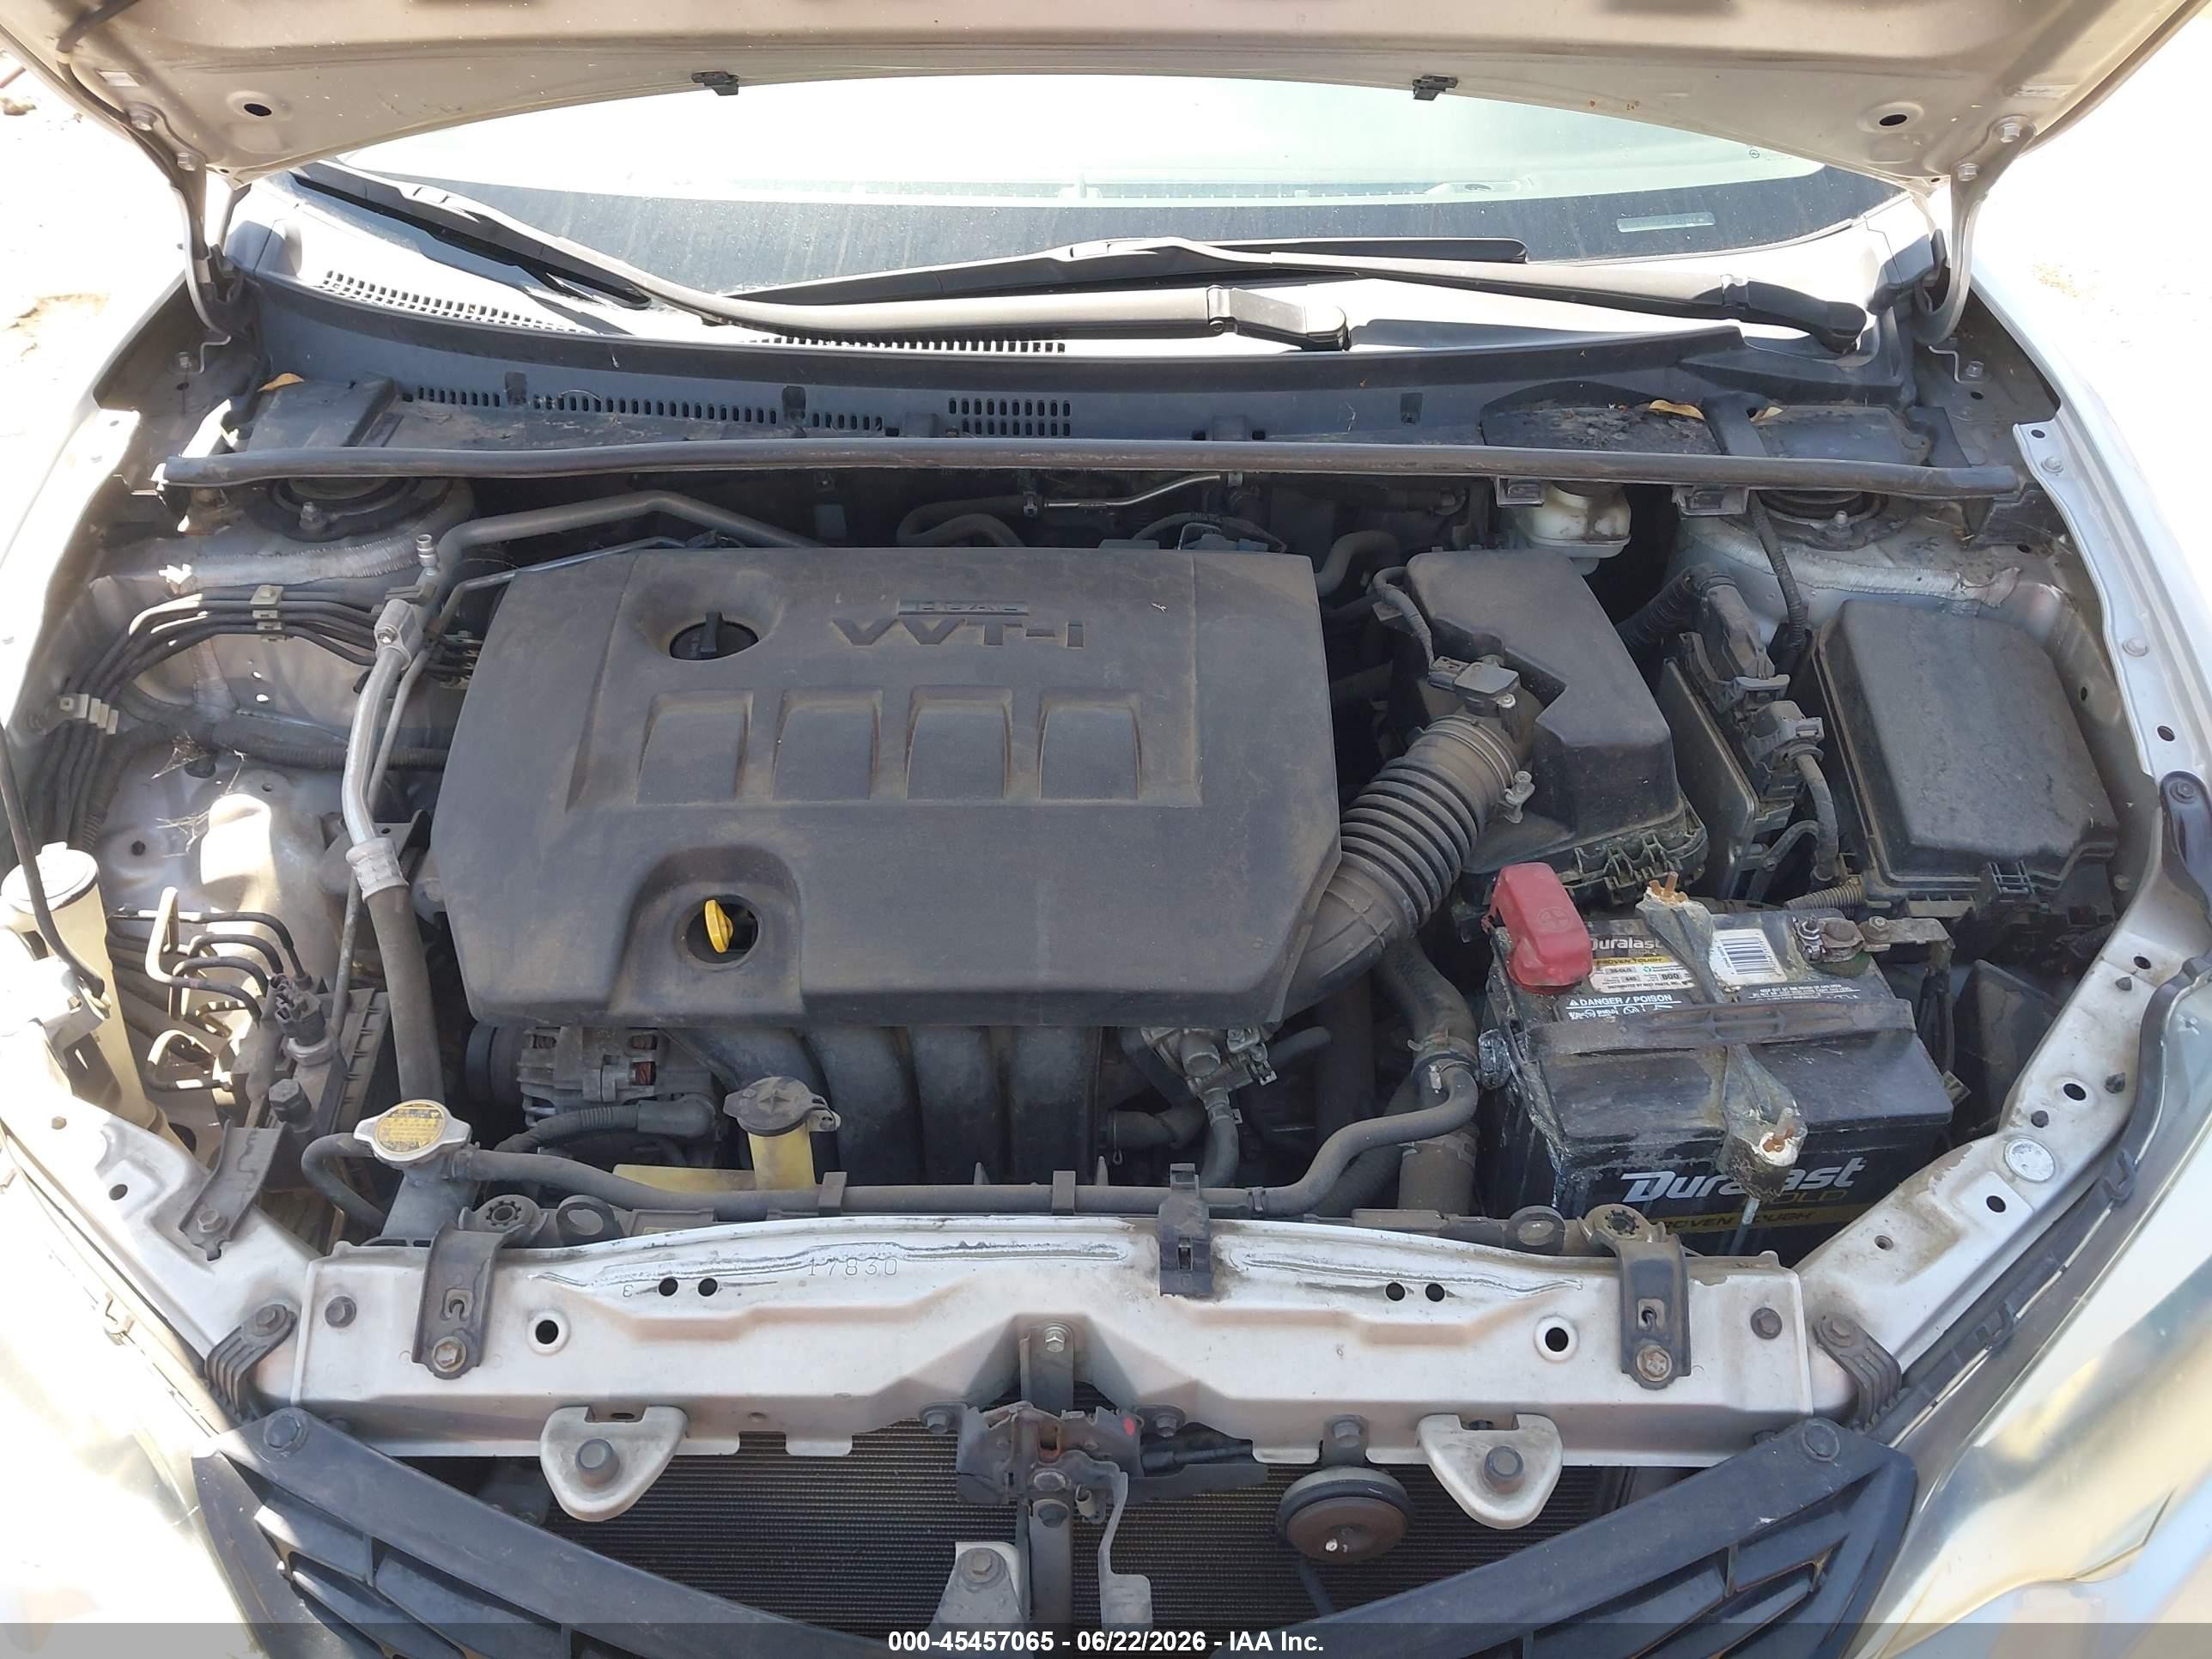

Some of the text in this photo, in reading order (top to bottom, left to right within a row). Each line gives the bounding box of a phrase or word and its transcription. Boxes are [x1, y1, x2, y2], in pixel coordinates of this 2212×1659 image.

[1579, 997, 1623, 1006] DANGER
[1632, 994, 1673, 1003] POISON
[1621, 1157, 1867, 1203] Duraast
[1770, 1188, 1849, 1204] OLD
[809, 1257, 897, 1277] 17830
